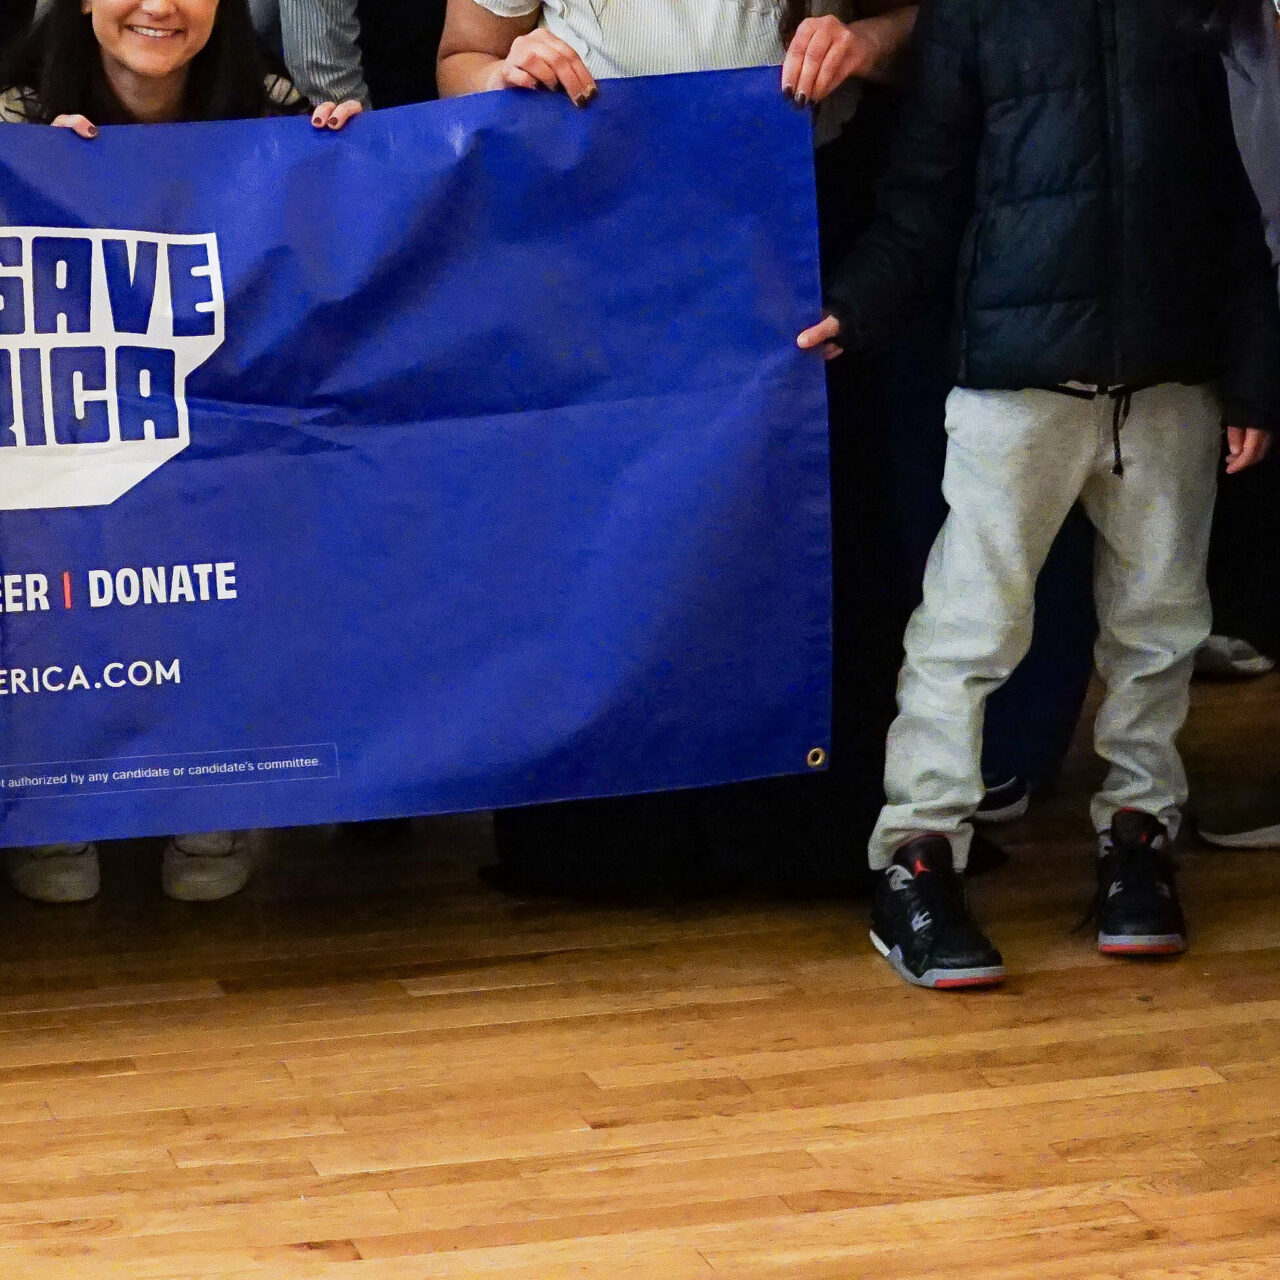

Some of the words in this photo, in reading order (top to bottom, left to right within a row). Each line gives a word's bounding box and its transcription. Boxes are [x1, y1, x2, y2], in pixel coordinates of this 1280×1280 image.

[88, 562, 238, 608] DONATE
[8, 774, 67, 788] authorized
[70, 772, 85, 785] by
[88, 772, 109, 784] any
[112, 767, 170, 779] candidate
[173, 767, 185, 776] or
[188, 761, 254, 775] candidate's
